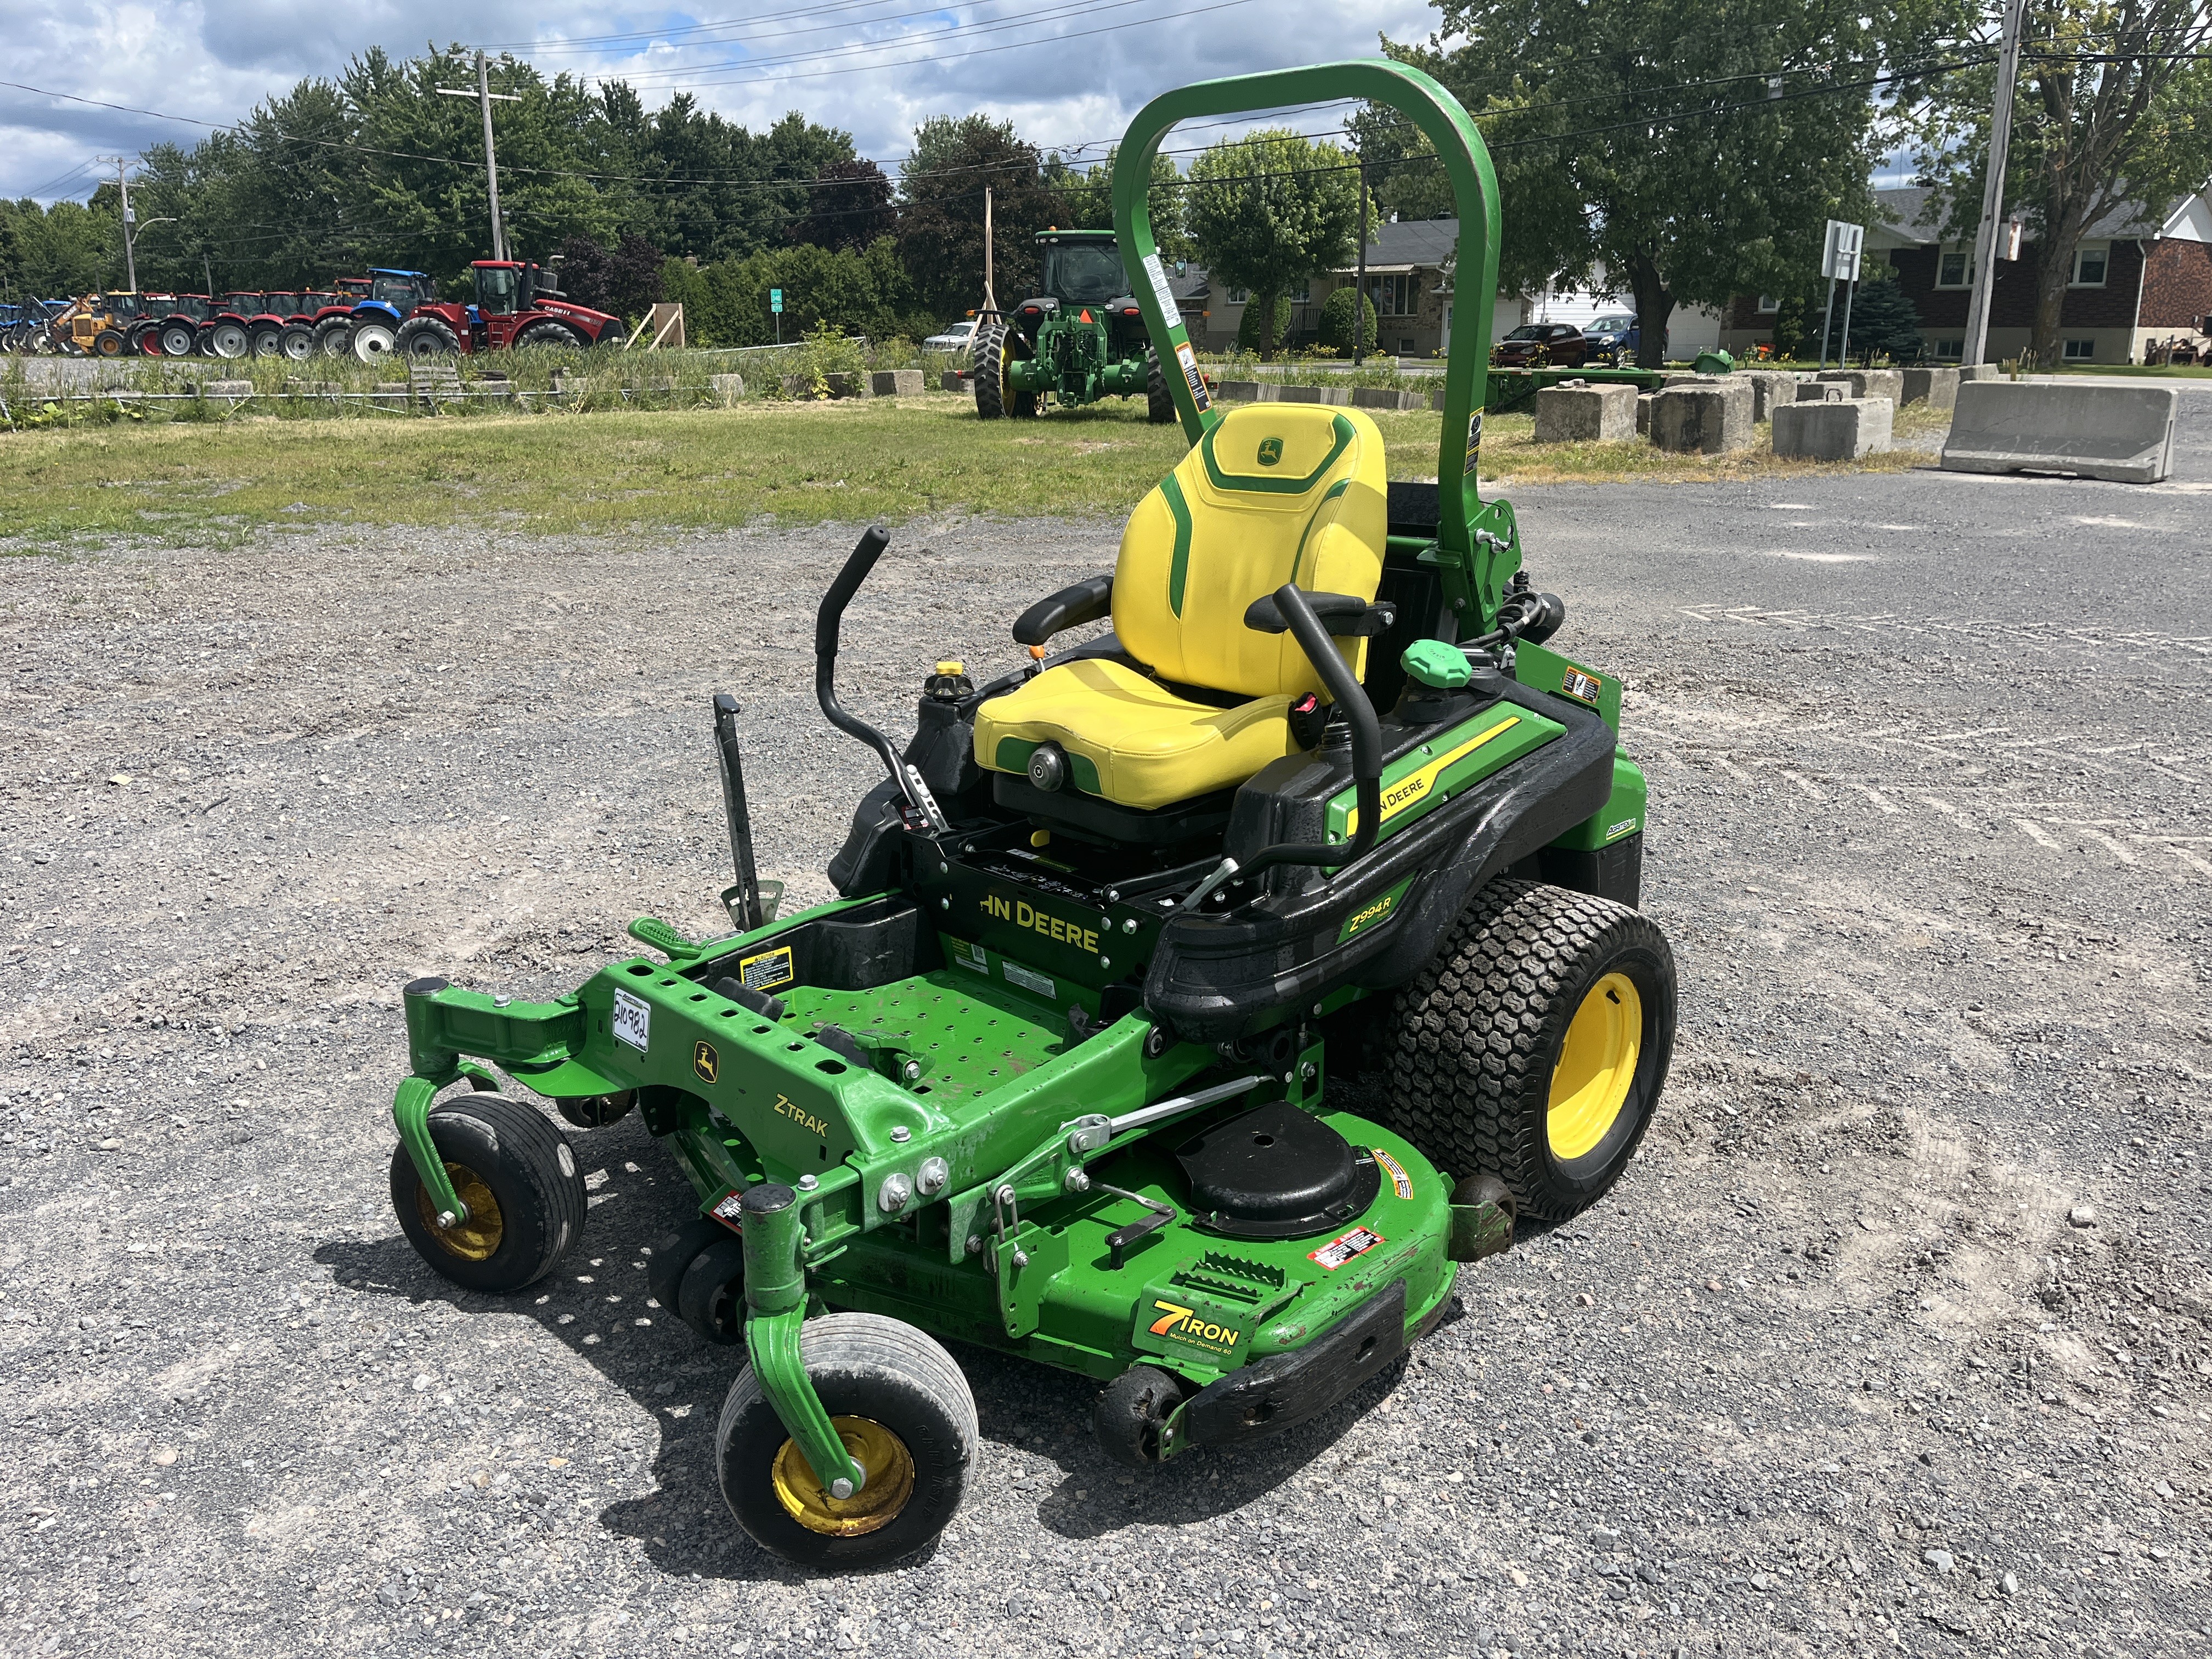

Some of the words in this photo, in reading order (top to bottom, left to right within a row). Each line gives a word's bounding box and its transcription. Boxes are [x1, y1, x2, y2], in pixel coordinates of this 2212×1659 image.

[1386, 778, 1425, 807] DEERE
[1017, 900, 1099, 954] DEERE
[1349, 896, 1391, 933] Z994R
[758, 952, 775, 961] CAUTION
[614, 1000, 647, 1040] 210982
[774, 1093, 828, 1138] ZTRAK
[1169, 1333, 1187, 1342] Mulch
[1197, 1341, 1222, 1352] Demand
